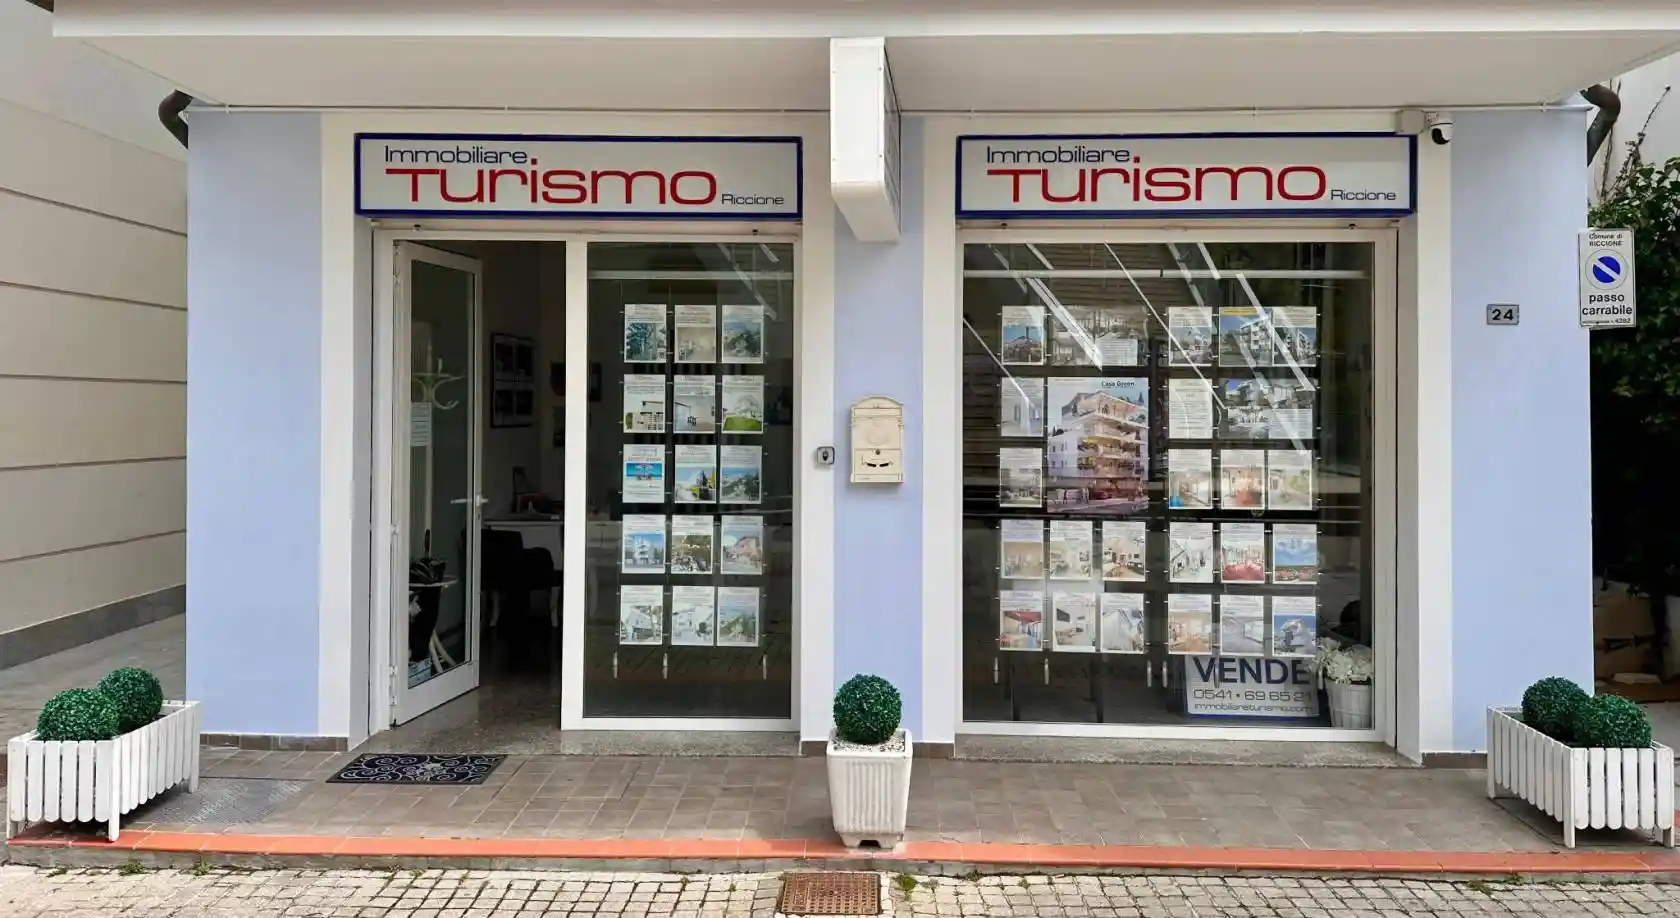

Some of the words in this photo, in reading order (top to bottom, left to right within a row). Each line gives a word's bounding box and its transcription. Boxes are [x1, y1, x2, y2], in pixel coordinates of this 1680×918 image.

[384, 145, 528, 164] Immobiliare
[986, 146, 1131, 164] Immobiliare
[385, 158, 717, 205] Turismo
[721, 193, 785, 205] Riccione
[987, 156, 1327, 203] Turismo
[1330, 190, 1397, 201] Riccione
[1589, 293, 1625, 304] passo
[1491, 308, 1514, 321] 24
[1582, 304, 1633, 316] carrabile
[1193, 688, 1232, 700] 0541
